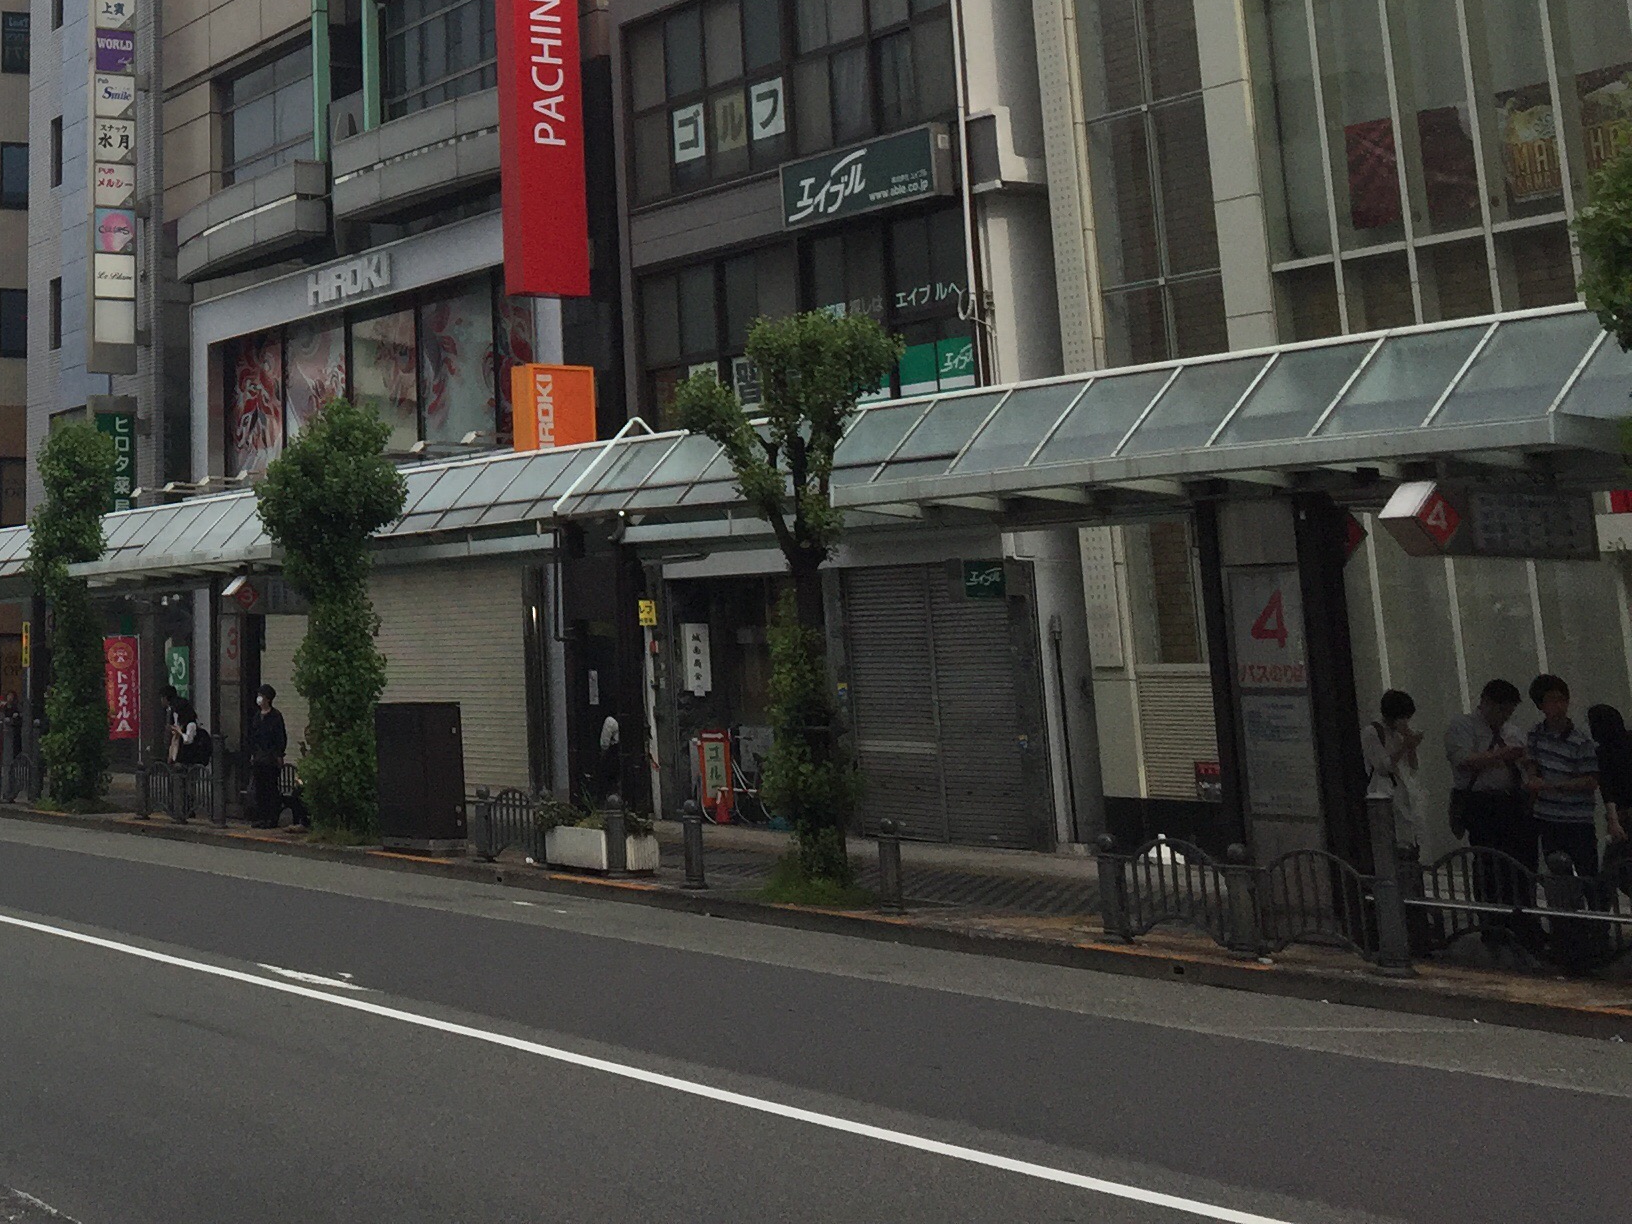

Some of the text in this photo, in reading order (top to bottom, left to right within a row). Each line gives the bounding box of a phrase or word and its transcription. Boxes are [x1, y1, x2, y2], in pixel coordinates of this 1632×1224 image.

[96, 37, 133, 51] WORLD
[102, 86, 131, 101] Smile
[676, 87, 779, 153] ゴルフ
[98, 133, 130, 150] 水月
[306, 252, 391, 307] HIROKI
[1250, 589, 1288, 648] 4
